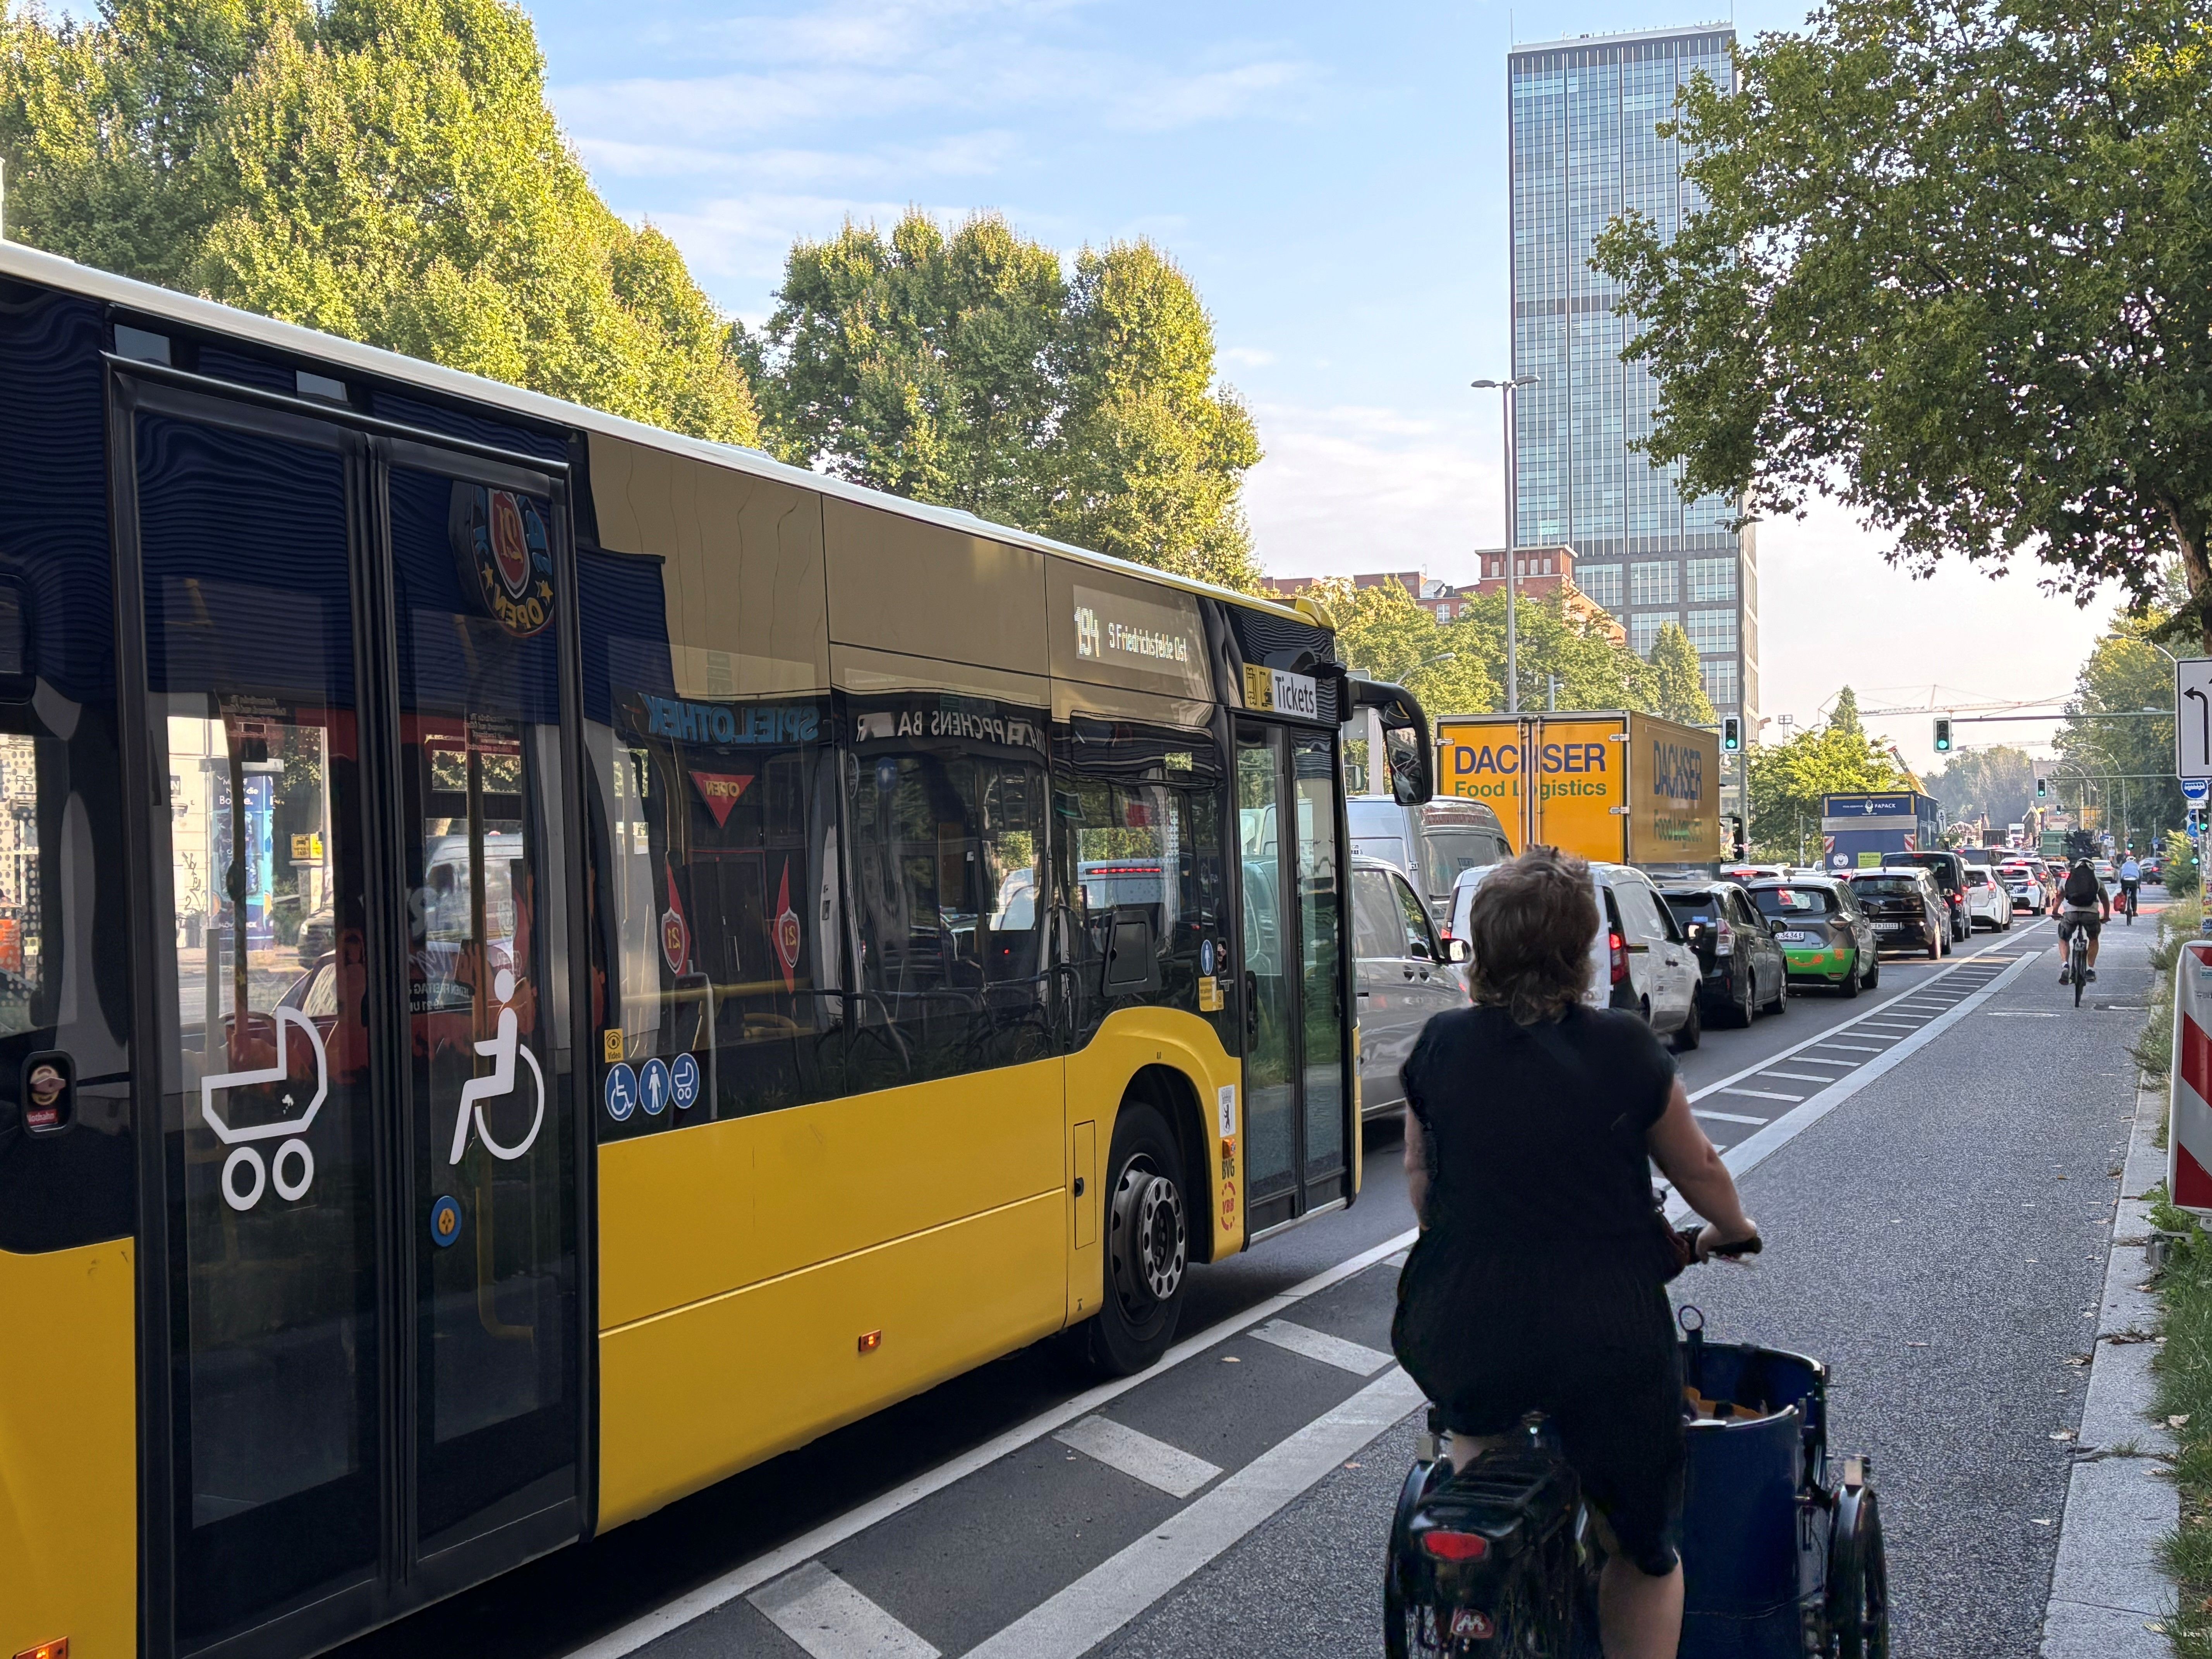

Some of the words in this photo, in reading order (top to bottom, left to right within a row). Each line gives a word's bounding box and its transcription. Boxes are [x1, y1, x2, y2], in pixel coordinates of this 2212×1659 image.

[1074, 606, 1099, 657] 194
[1108, 623, 1115, 648] S
[1275, 676, 1314, 713] Tickets
[1455, 743, 1606, 774] DACHSER
[1654, 740, 1702, 801] DACHSER
[1455, 781, 1505, 797] Food
[1513, 779, 1606, 800] Lgistics
[1222, 1158, 1235, 1180] BVG
[1223, 1198, 1234, 1214] VBB
